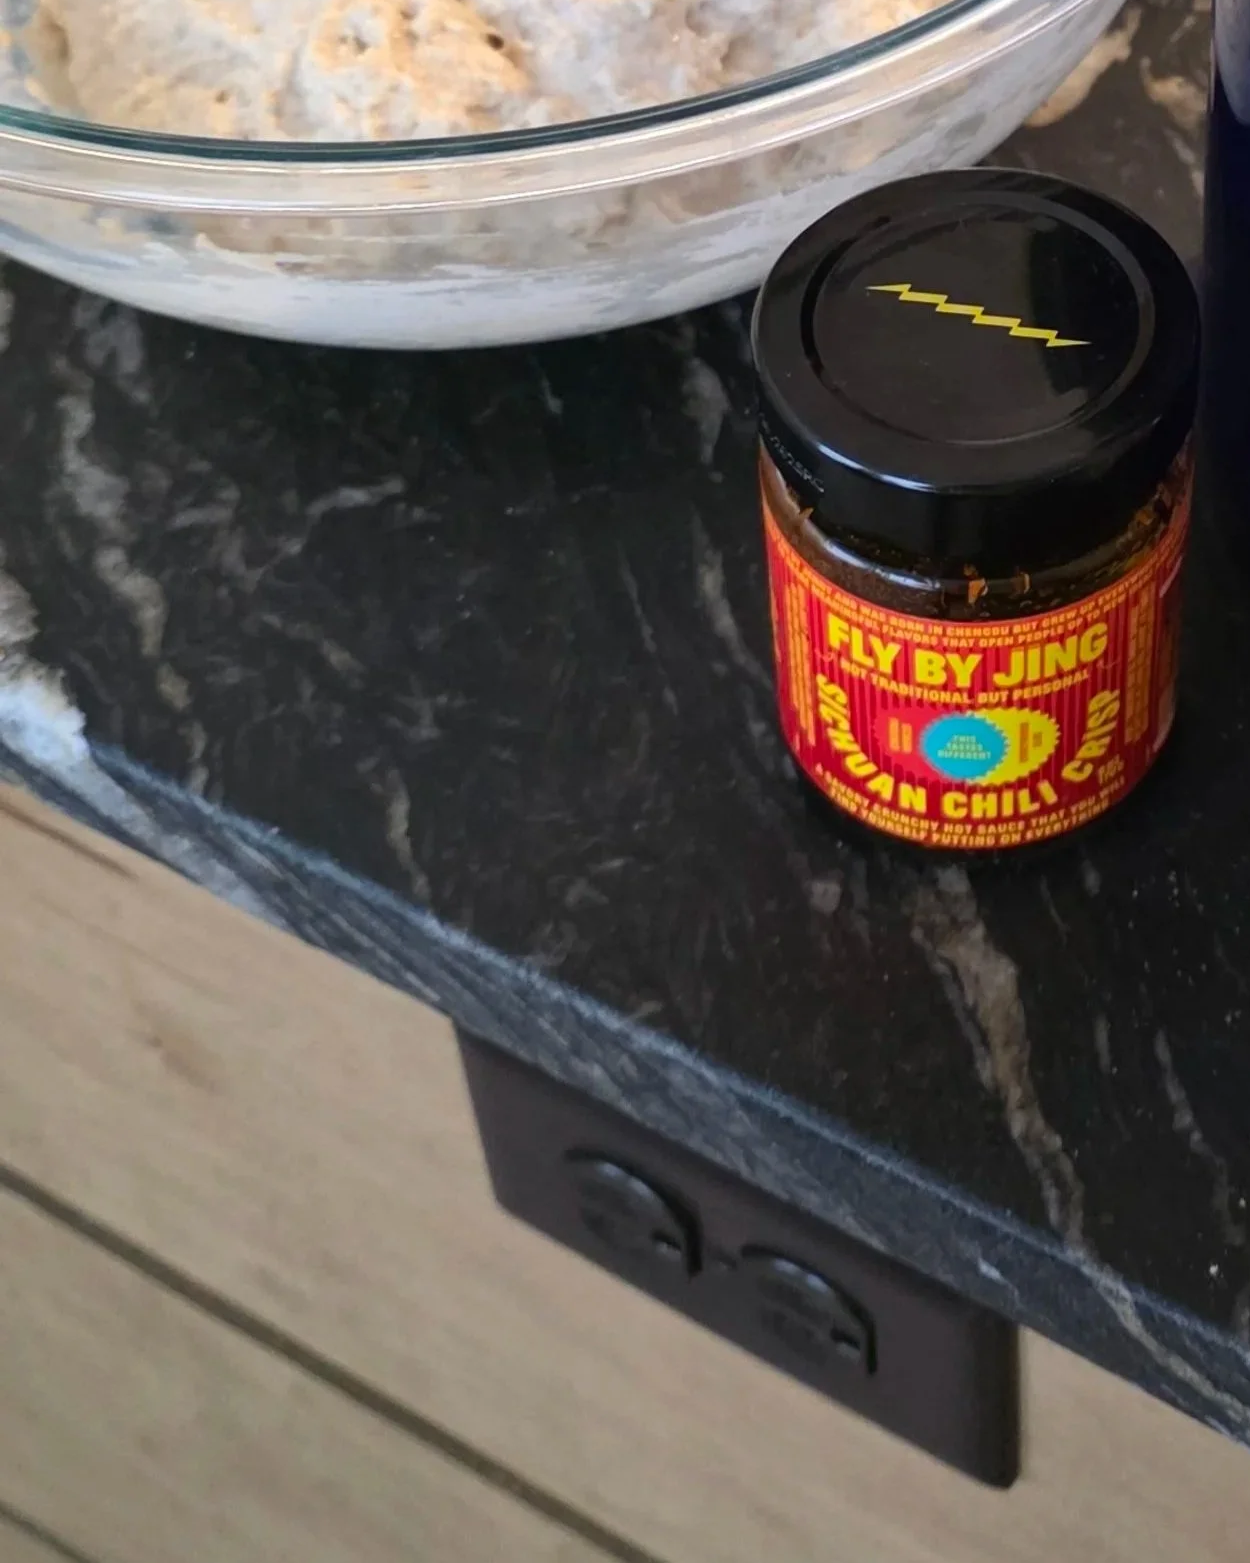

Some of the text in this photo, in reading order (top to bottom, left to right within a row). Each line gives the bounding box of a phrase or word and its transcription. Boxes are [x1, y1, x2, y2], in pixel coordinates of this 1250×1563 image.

[881, 622, 939, 646] FLAVORS
[941, 636, 975, 648] THAT
[979, 635, 1015, 648] OPEN
[1017, 623, 1065, 645] PEOPLE
[1086, 608, 1101, 624] TO
[889, 615, 925, 633] BORN
[928, 622, 944, 635] IN
[946, 625, 1010, 637] CHENGDU
[1012, 621, 1038, 635] BUT
[1041, 608, 1078, 629] GREW
[1079, 600, 1096, 615] UP
[827, 612, 1108, 688] FLY BY JING
[870, 671, 972, 705] TRADITIONAL
[977, 690, 1010, 704] BUT
[1012, 668, 1089, 702] PERSONAL
[815, 673, 1121, 820] SICHUAN CHILI CRISP
[872, 802, 940, 831] CRUNCHY
[943, 822, 973, 834] HOT
[977, 820, 1025, 834] SAUCE
[1030, 808, 1066, 828] THAT
[1000, 831, 1022, 846] ON
